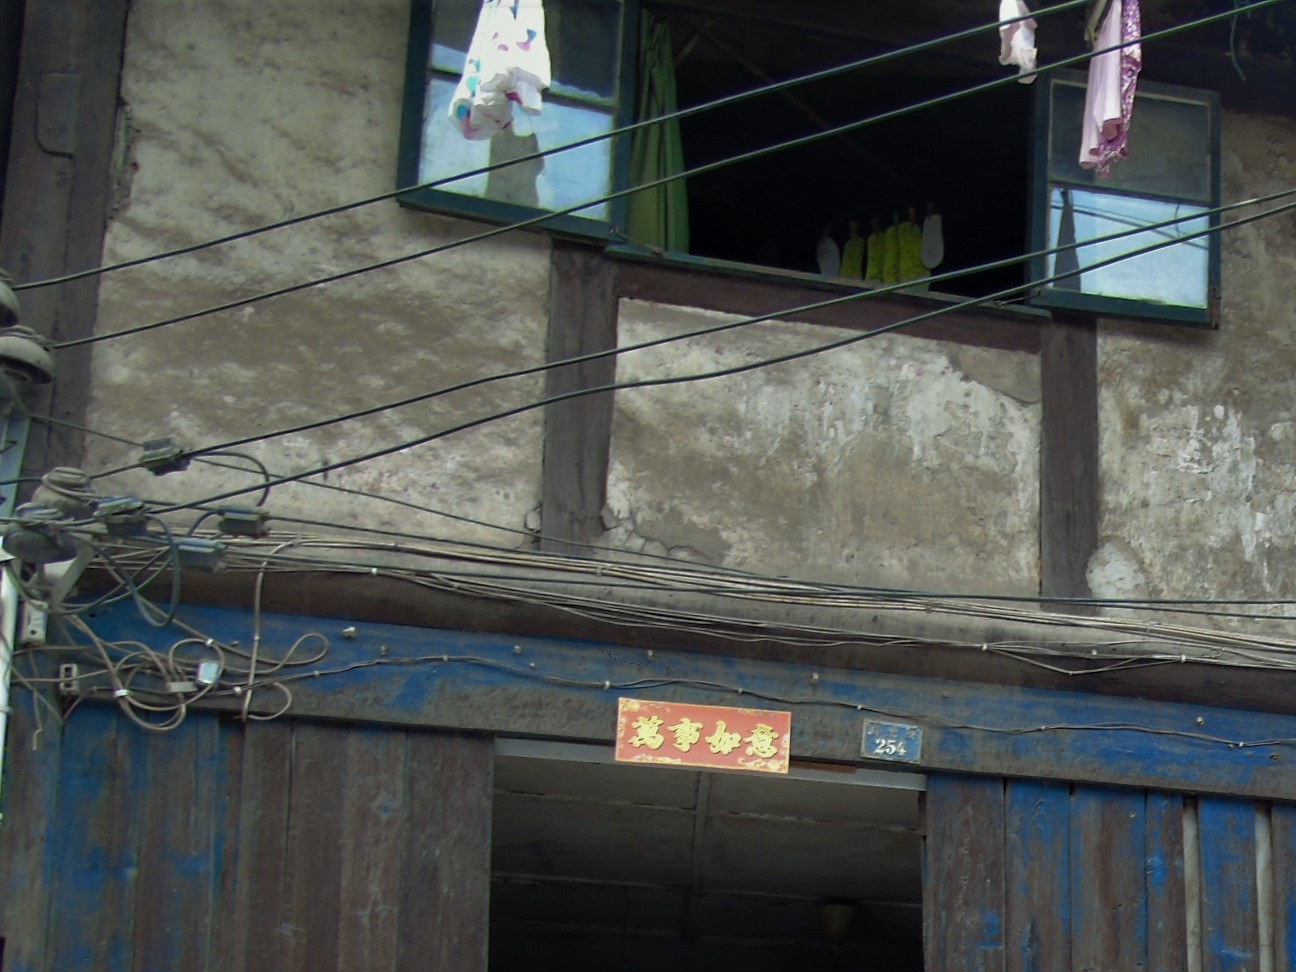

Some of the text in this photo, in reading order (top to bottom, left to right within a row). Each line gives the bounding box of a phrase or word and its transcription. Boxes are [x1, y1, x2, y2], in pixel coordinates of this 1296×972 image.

[628, 715, 779, 759] 萬事如意
[873, 738, 907, 757] 254
